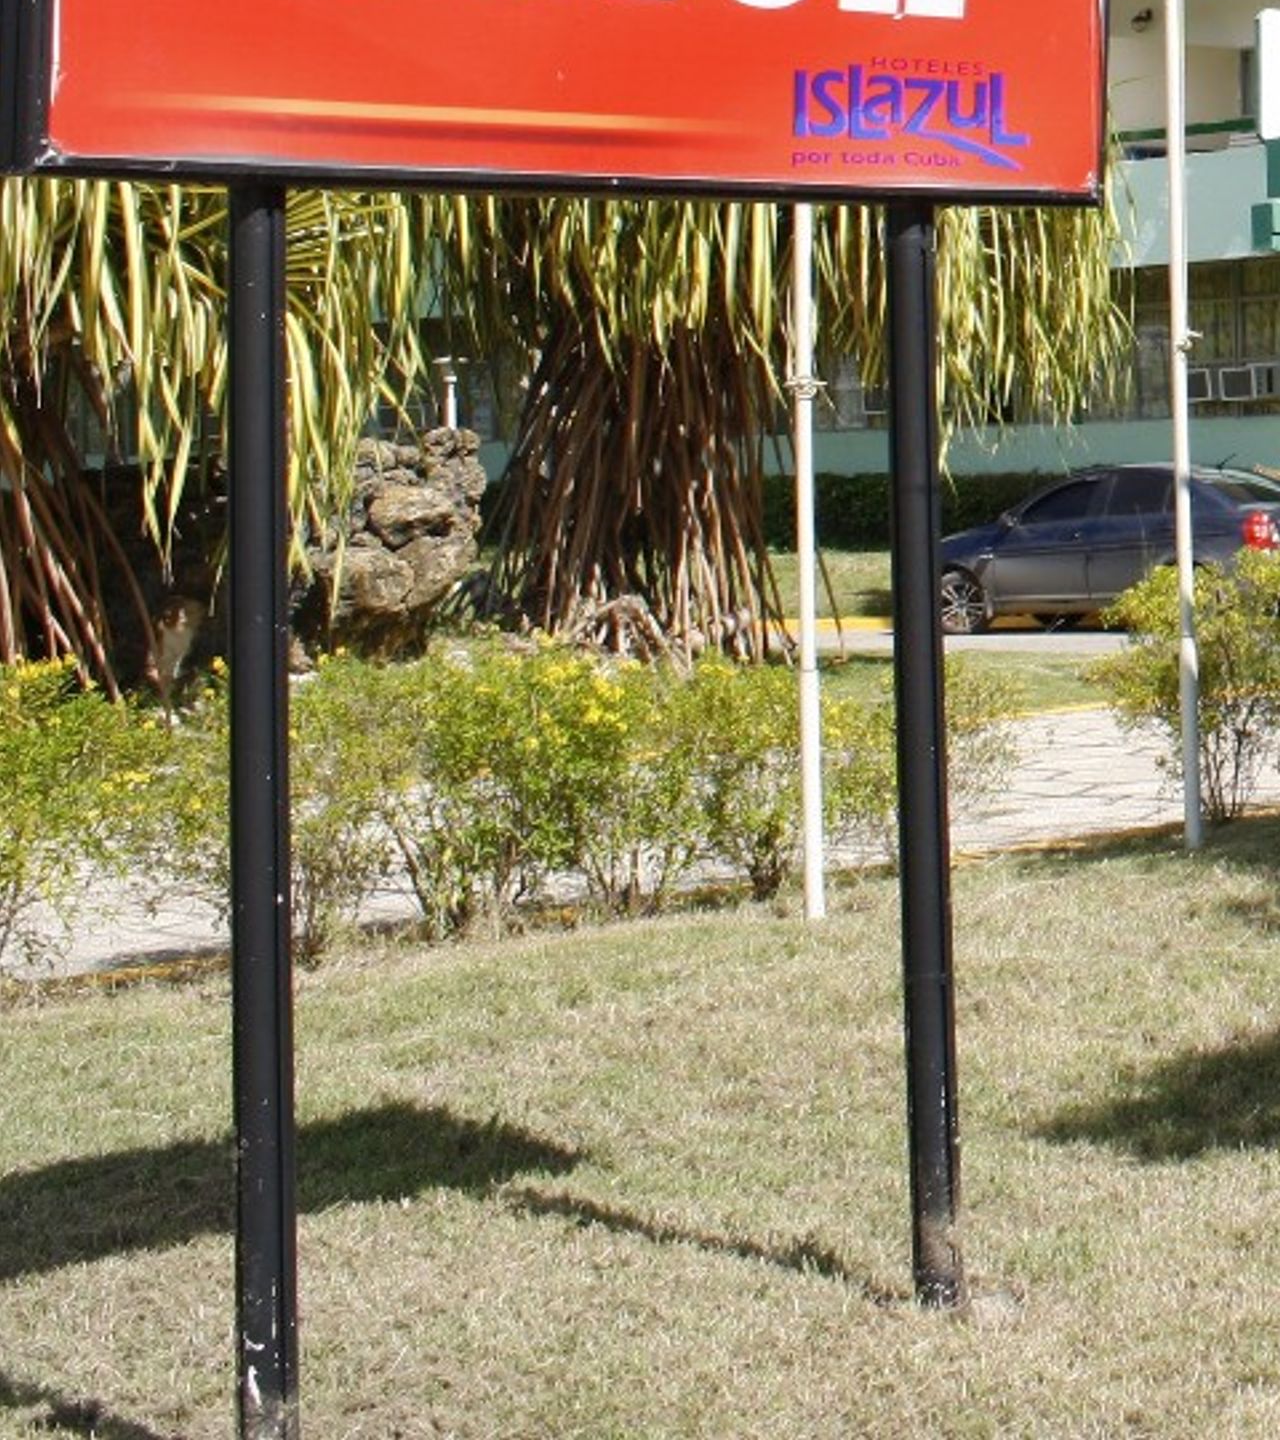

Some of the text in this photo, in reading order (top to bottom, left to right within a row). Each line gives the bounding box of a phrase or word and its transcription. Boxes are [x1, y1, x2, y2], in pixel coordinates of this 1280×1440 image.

[870, 56, 985, 77] HOTELES
[791, 150, 962, 168] por toda Cuba
